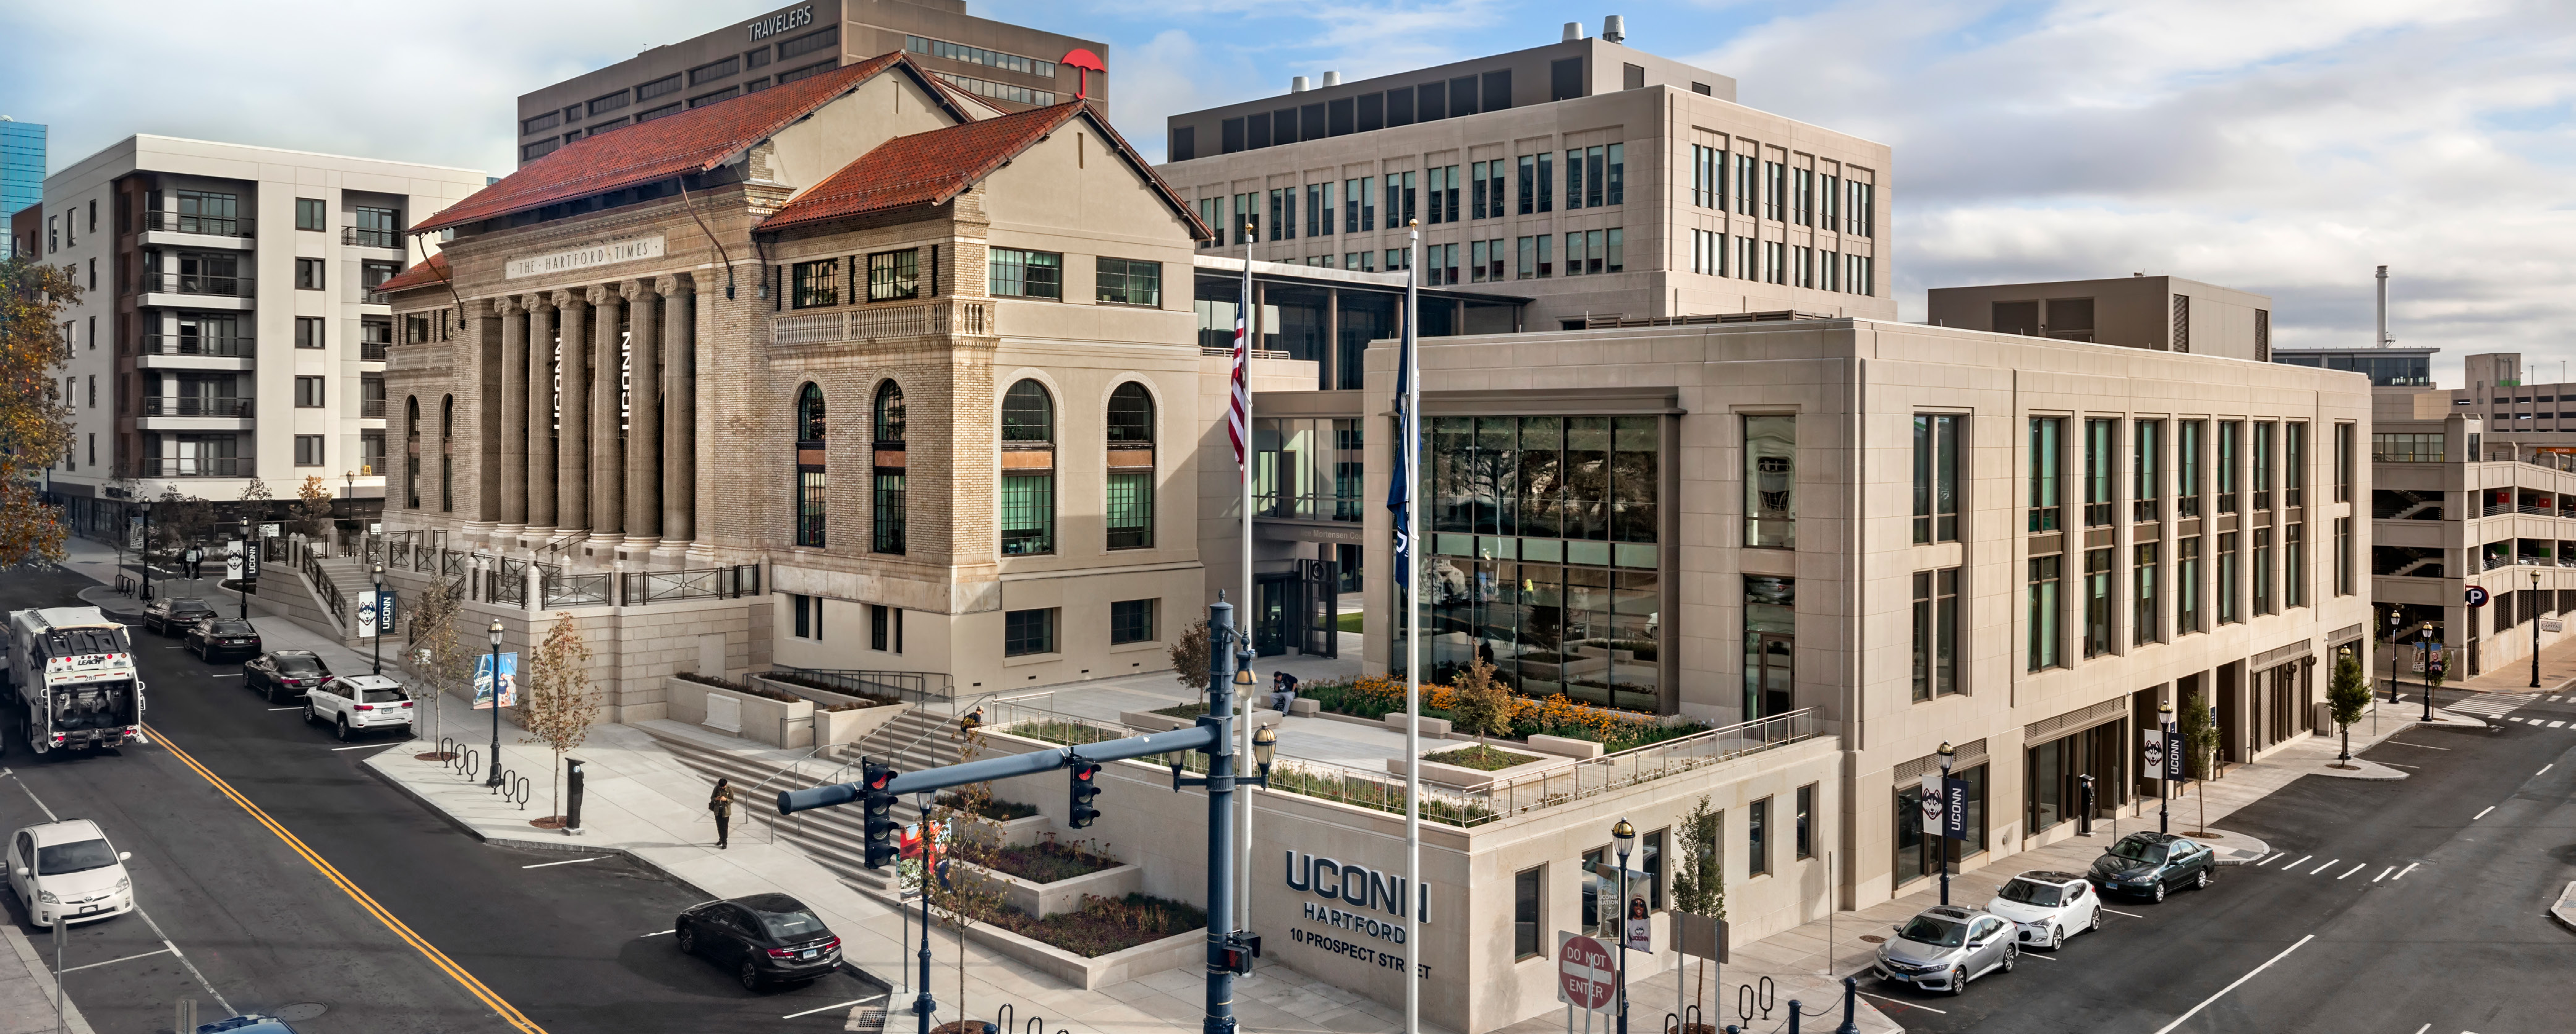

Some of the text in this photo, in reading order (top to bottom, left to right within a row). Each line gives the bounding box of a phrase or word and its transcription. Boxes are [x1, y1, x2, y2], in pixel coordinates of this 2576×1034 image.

[747, 5, 811, 41] TRAVELERS
[519, 242, 648, 274] THE HARTFORD TIMES
[1313, 529, 1348, 539] Mortensen
[383, 597, 391, 630] UCONN
[2470, 591, 2483, 604] P
[474, 675, 491, 683] UCONN
[2170, 740, 2179, 774] UCONN
[1951, 787, 1962, 831] UCONN
[1286, 850, 1431, 924] UCONN
[1304, 902, 1406, 944] HARTFORD
[1290, 928, 1432, 980] 10 PROSPECT STRET
[1567, 946, 1606, 967] DO NOT
